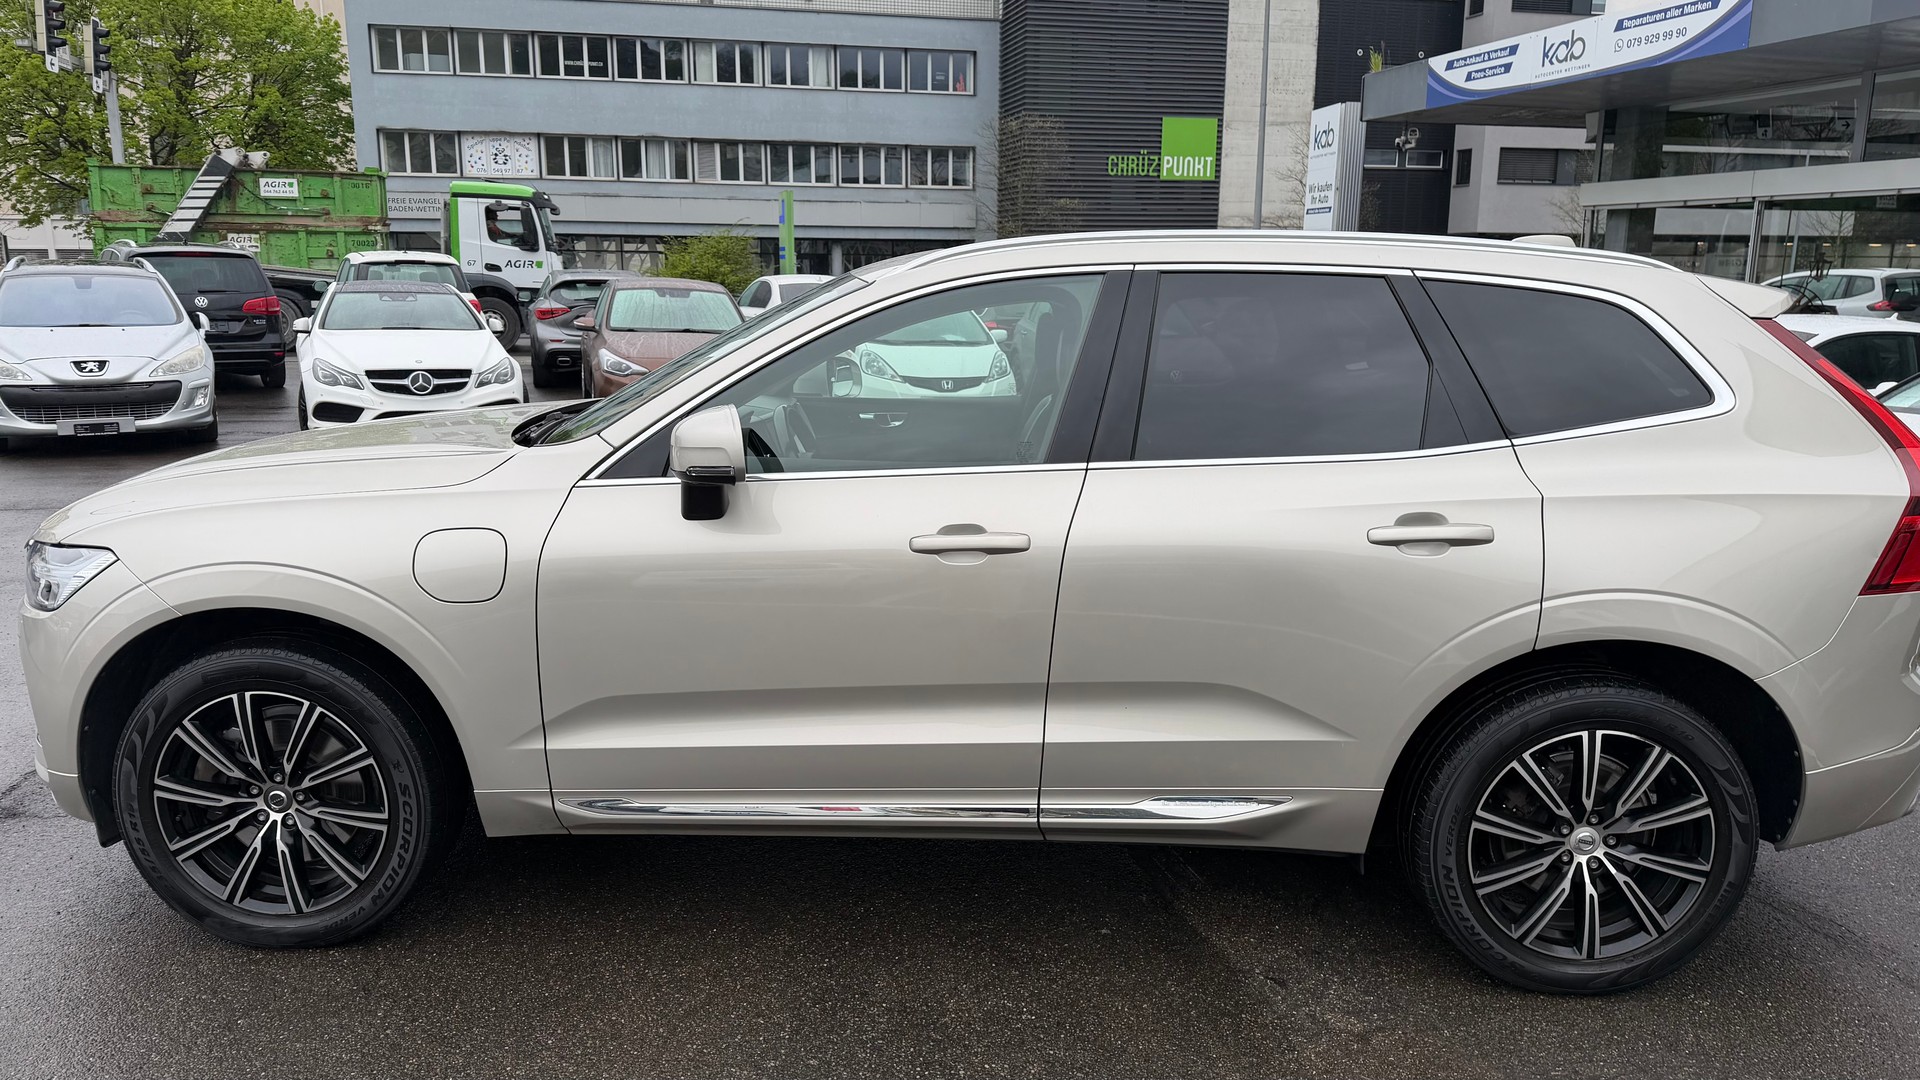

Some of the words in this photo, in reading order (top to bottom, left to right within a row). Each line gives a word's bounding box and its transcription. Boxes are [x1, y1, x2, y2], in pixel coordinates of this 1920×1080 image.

[1622, 12, 1665, 29] Reparaturen
[1666, 7, 1683, 19] aller
[1683, 0, 1712, 15] Marken
[1626, 36, 1643, 49] 079
[1644, 32, 1661, 45] 929
[1662, 29, 1674, 41] 99
[1675, 26, 1688, 39] 90
[1541, 29, 1586, 68] kab
[1452, 52, 1485, 68] Auto-Ankauf
[1489, 47, 1511, 61] Verkauf
[1471, 65, 1505, 80] Pneu-Service
[1535, 69, 1563, 79] AUTOCENTER
[1564, 63, 1591, 74] WETTINGEN
[1313, 121, 1335, 151] kab
[263, 181, 287, 189] AGIR
[1308, 183, 1317, 194] Wir
[1317, 180, 1333, 194] kaufen
[1318, 194, 1329, 205] Auto
[229, 236, 253, 244] AGIR
[466, 259, 477, 267] 67
[504, 259, 535, 269] AGIR
[1445, 803, 1463, 858] VERDE
[370, 782, 414, 906] SCORPION
